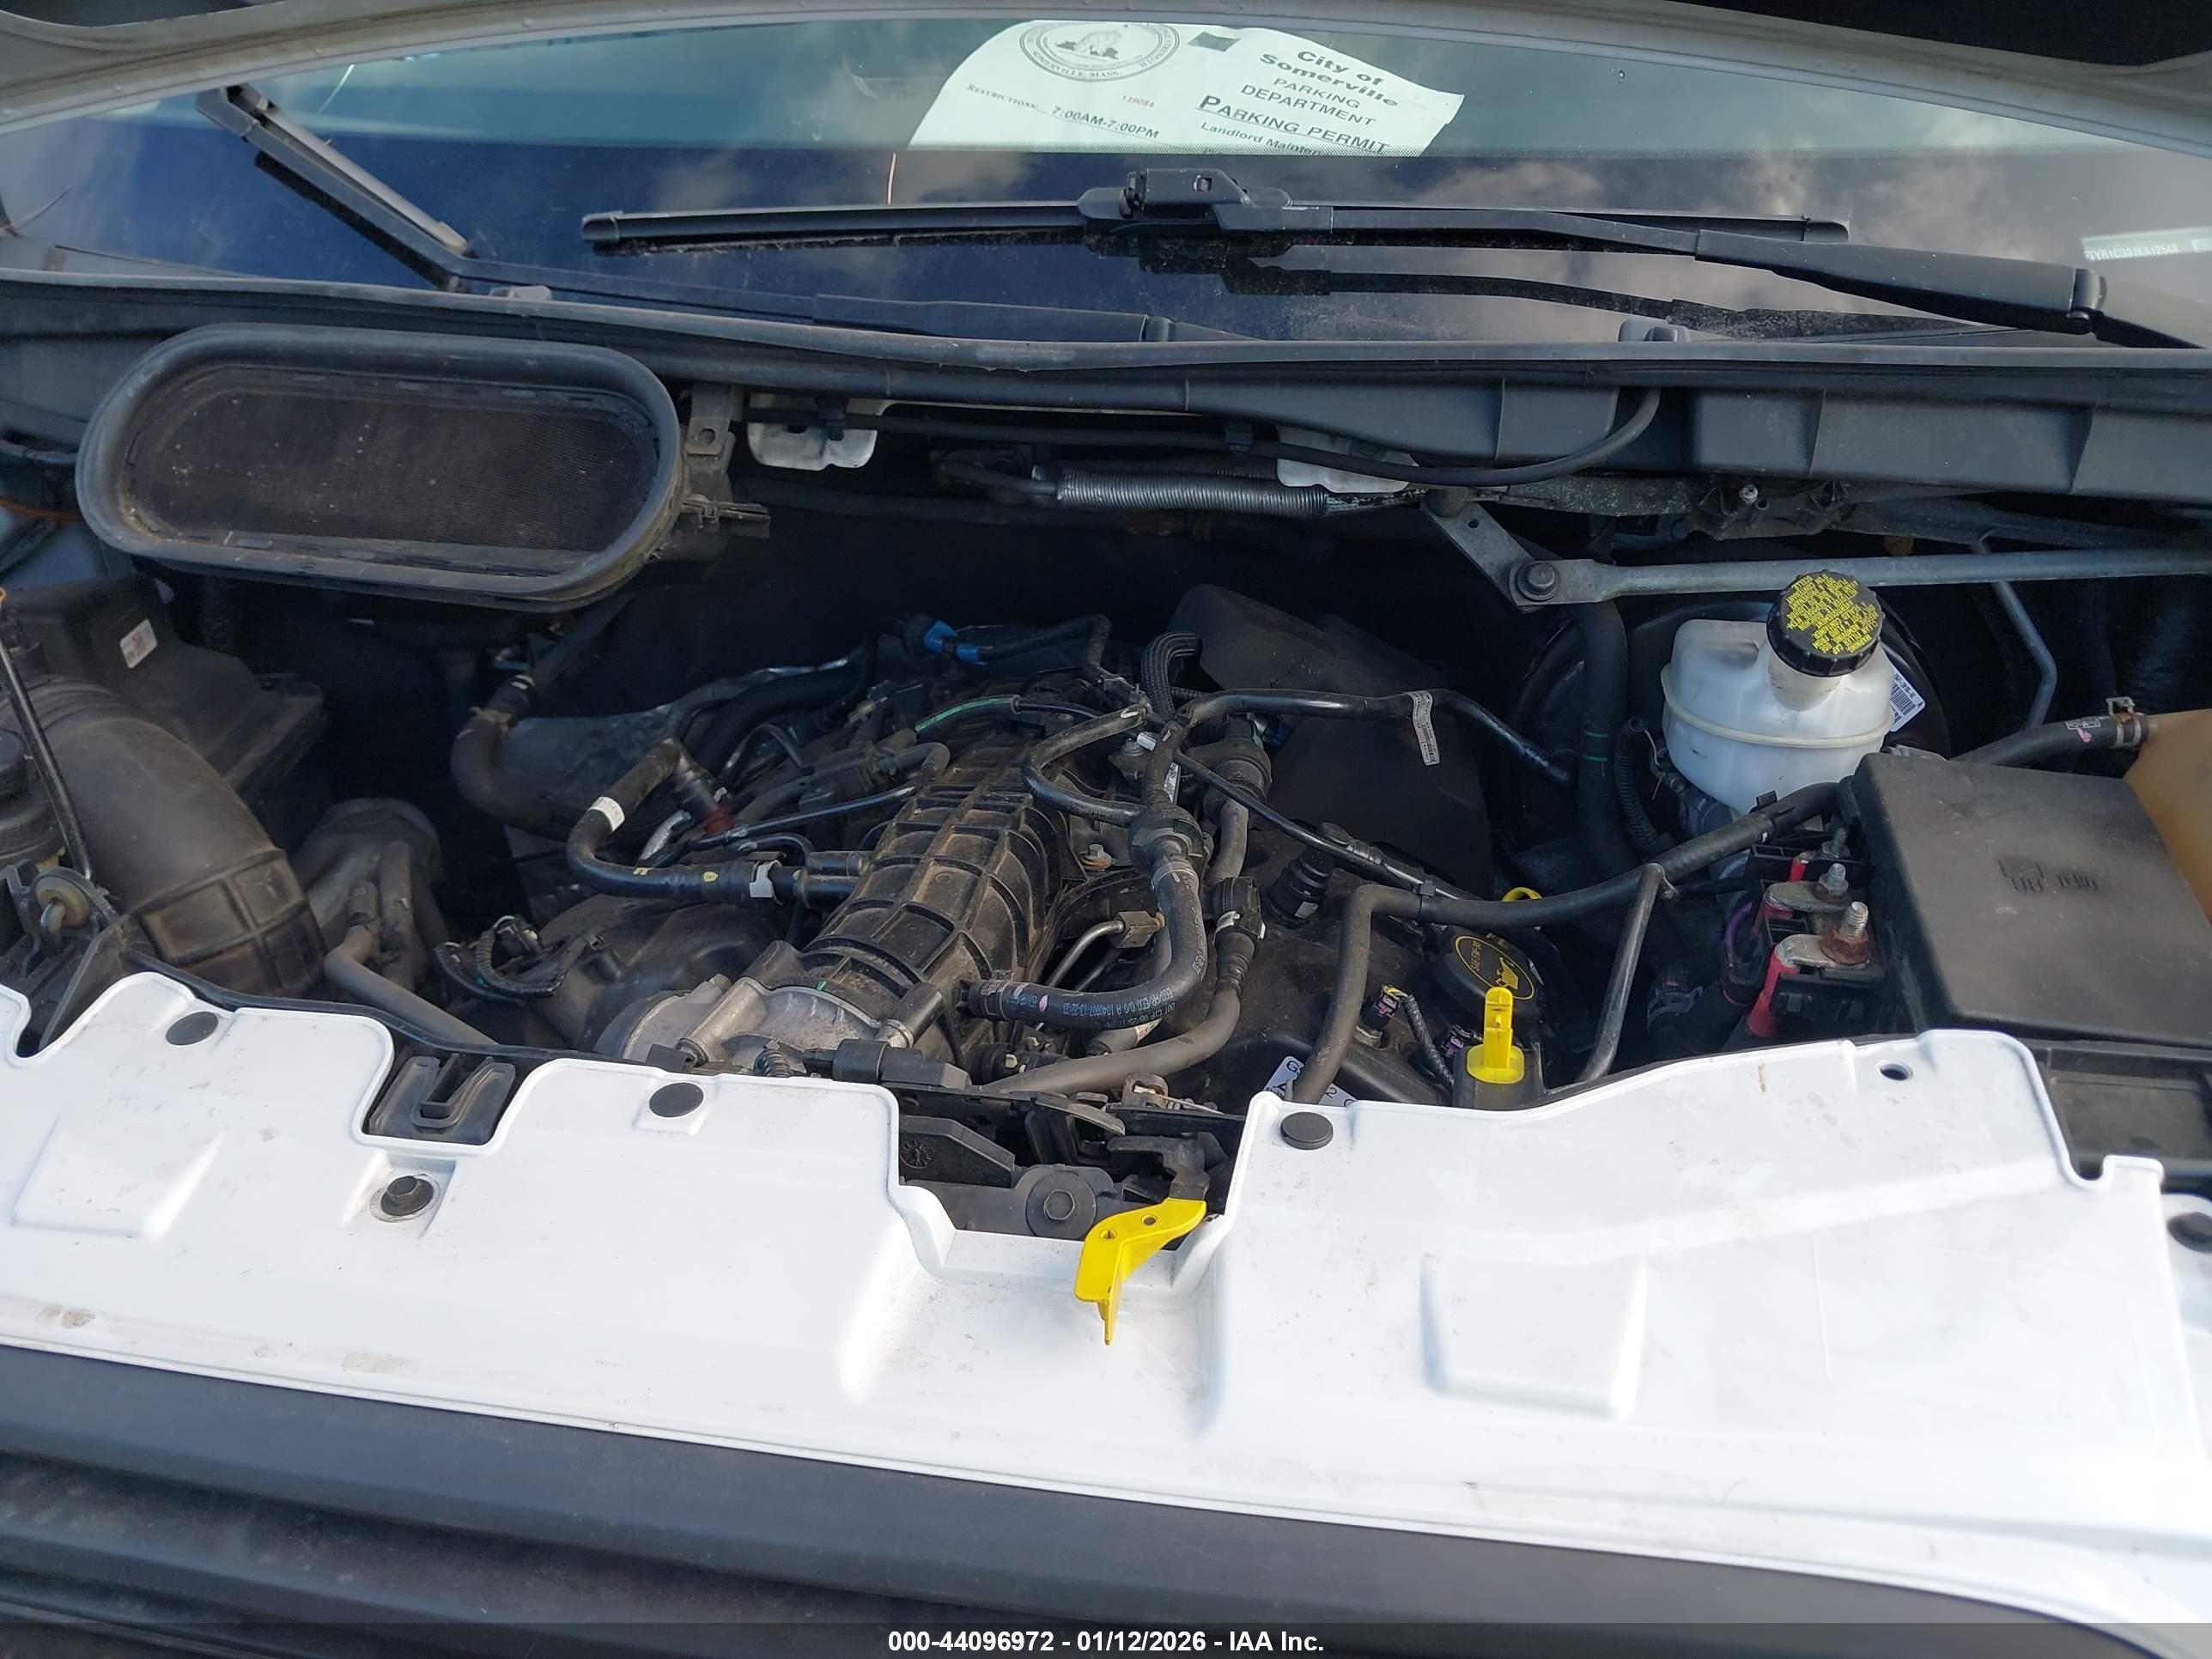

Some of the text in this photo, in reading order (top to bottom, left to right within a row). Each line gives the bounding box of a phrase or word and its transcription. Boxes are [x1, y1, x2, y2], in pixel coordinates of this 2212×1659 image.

[1260, 53, 1398, 106] Somerville
[1297, 51, 1384, 85] City of
[1241, 84, 1376, 126] DEPARTMENT
[1273, 77, 1360, 109] PARKING
[1052, 106, 1159, 139] 7:00AM-7:00PM
[1201, 121, 1263, 144] Landlord
[1308, 127, 1390, 155] PERMIT
